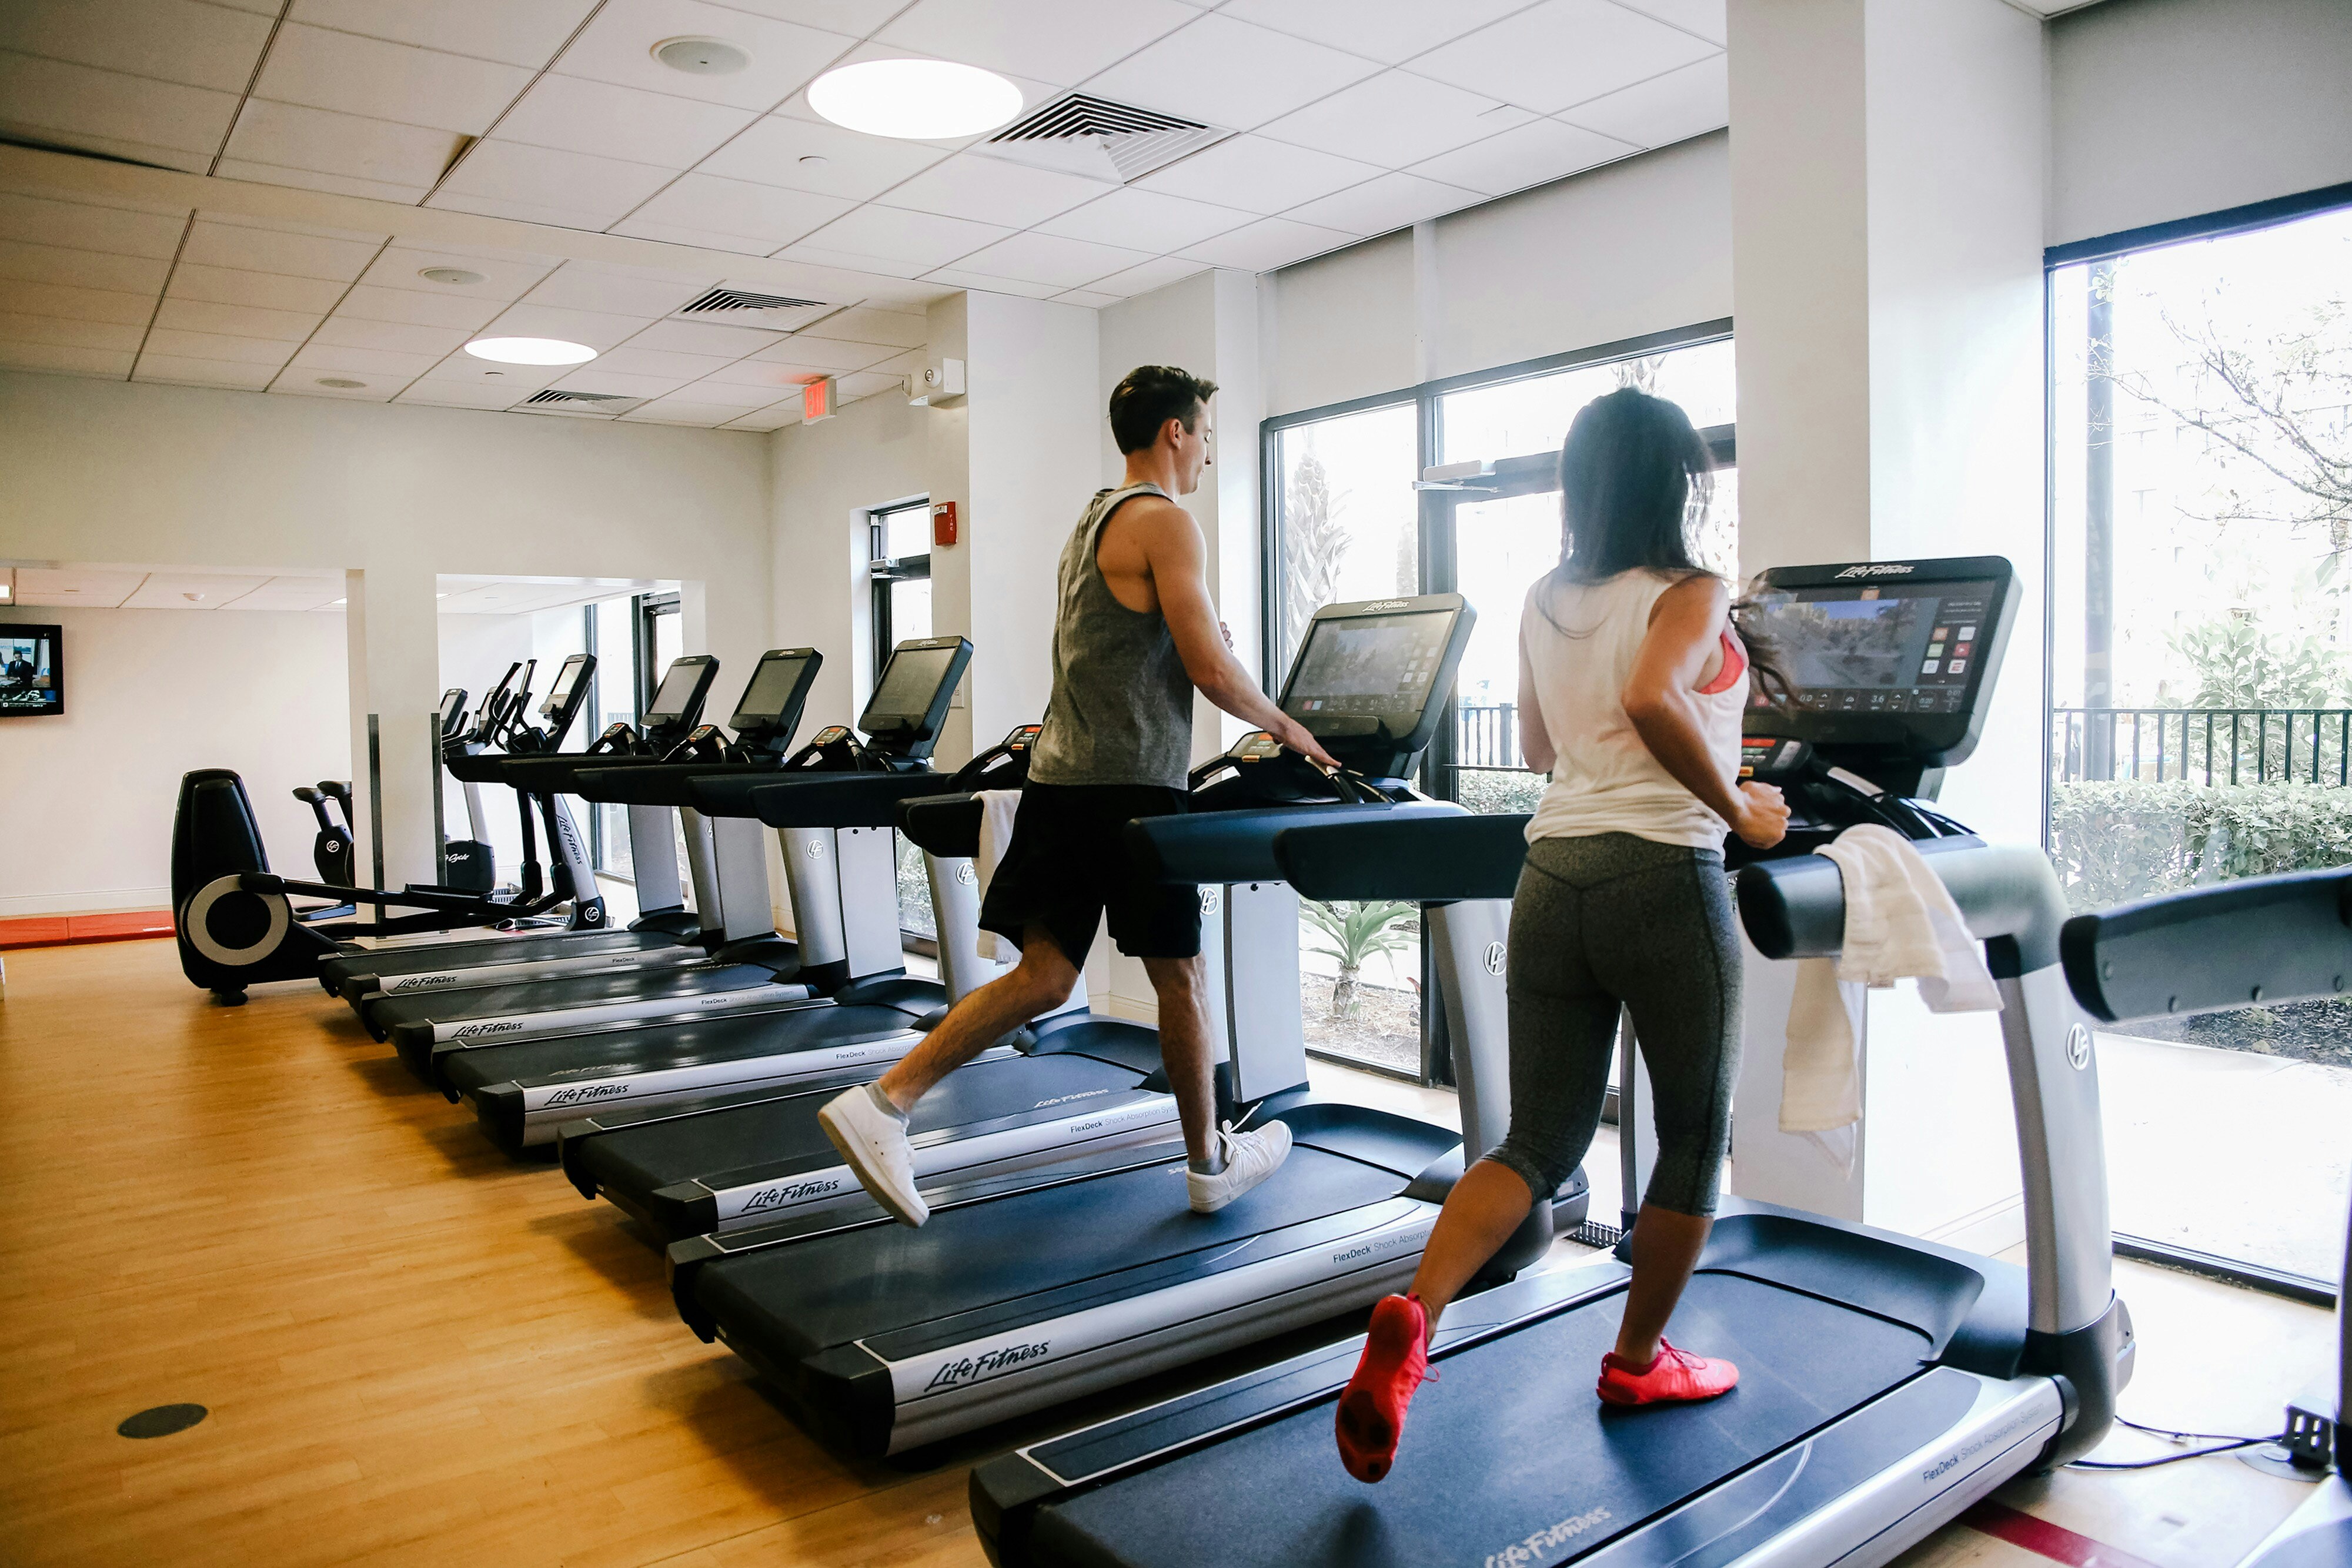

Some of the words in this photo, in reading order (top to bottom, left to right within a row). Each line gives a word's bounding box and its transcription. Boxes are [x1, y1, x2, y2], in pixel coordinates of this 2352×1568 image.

[701, 995, 727, 1006] FlexDeck
[836, 1049, 866, 1060] FlexDeck
[1070, 1119, 1103, 1134] FlexDeck
[1104, 1114, 1125, 1127] Shock
[1126, 1107, 1160, 1124] Absorption
[1332, 1245, 1372, 1263] FlexDeck
[1373, 1236, 1398, 1252] Shock
[1923, 1455, 1959, 1483] FlexDeck
